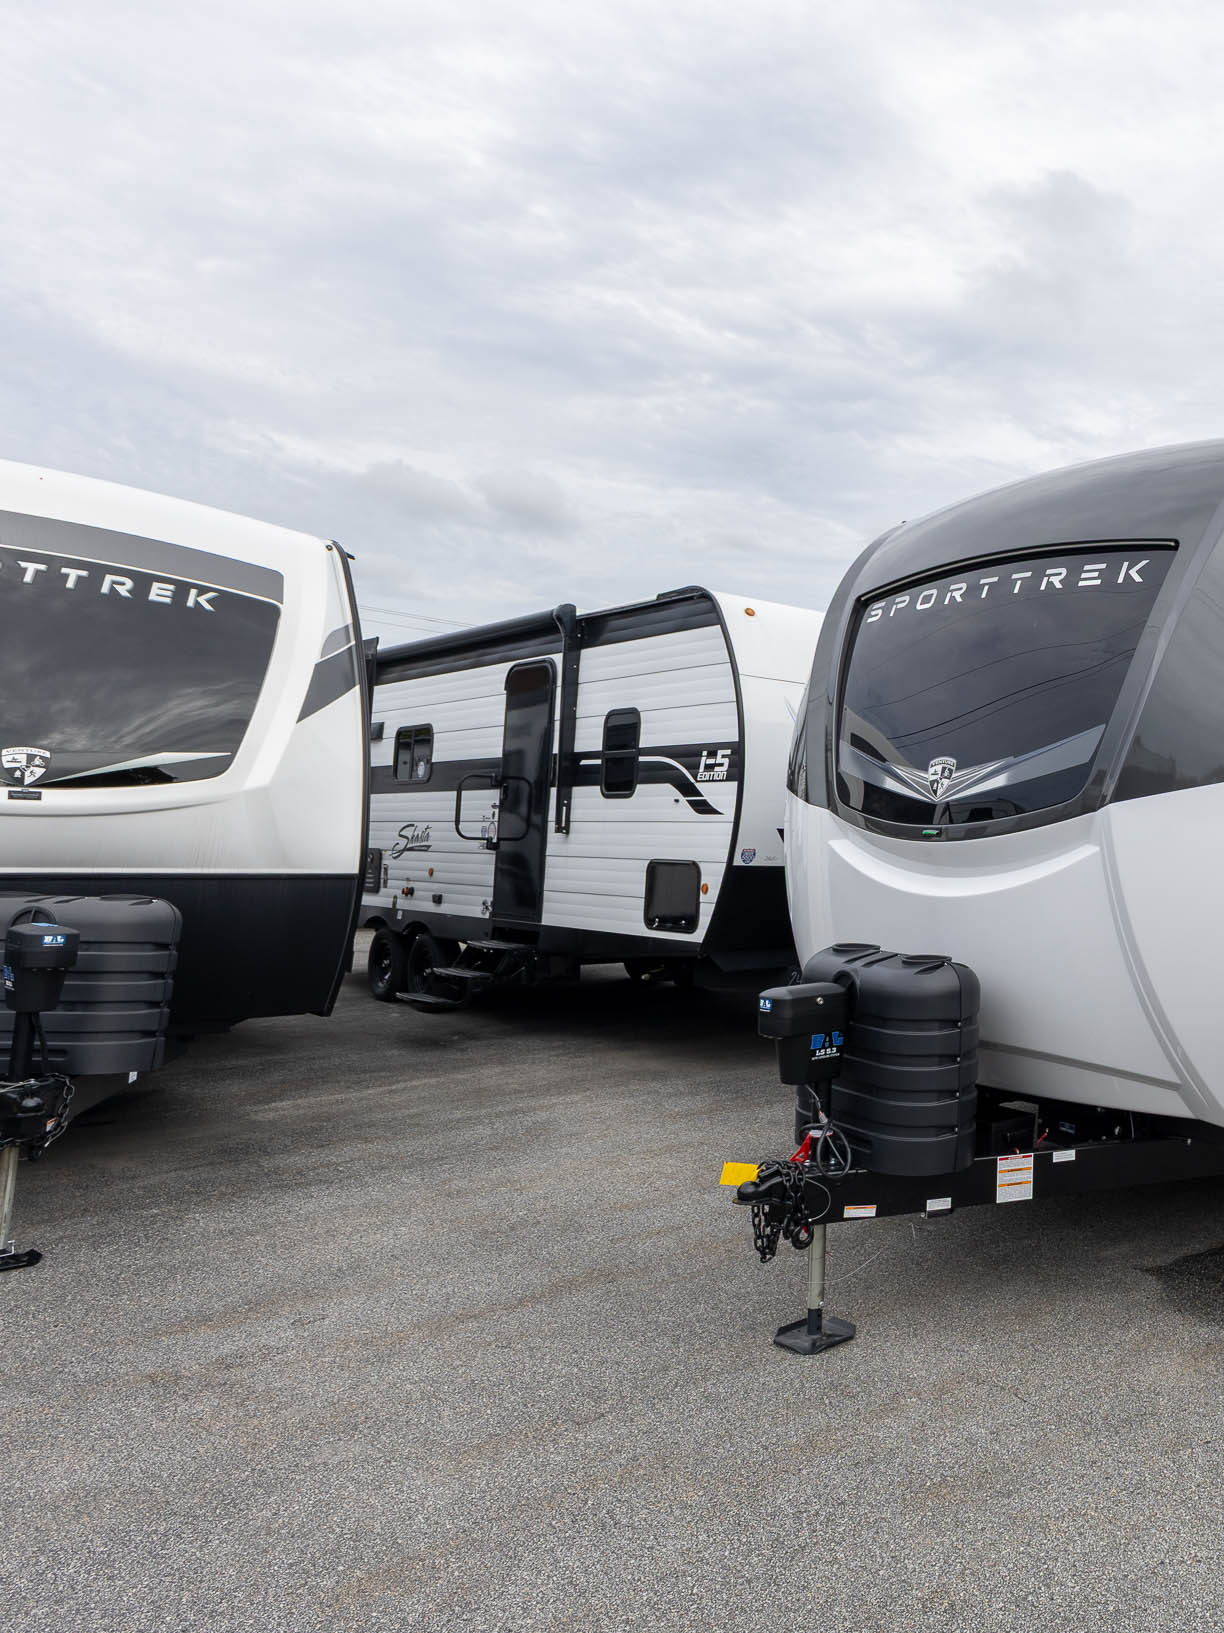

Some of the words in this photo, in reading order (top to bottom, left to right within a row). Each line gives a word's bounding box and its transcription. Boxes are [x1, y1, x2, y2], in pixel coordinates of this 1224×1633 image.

[0, 560, 220, 612] TTREK
[866, 559, 1150, 623] SPORTTREK
[697, 771, 727, 781] EDITION
[390, 823, 432, 859] Shasta
